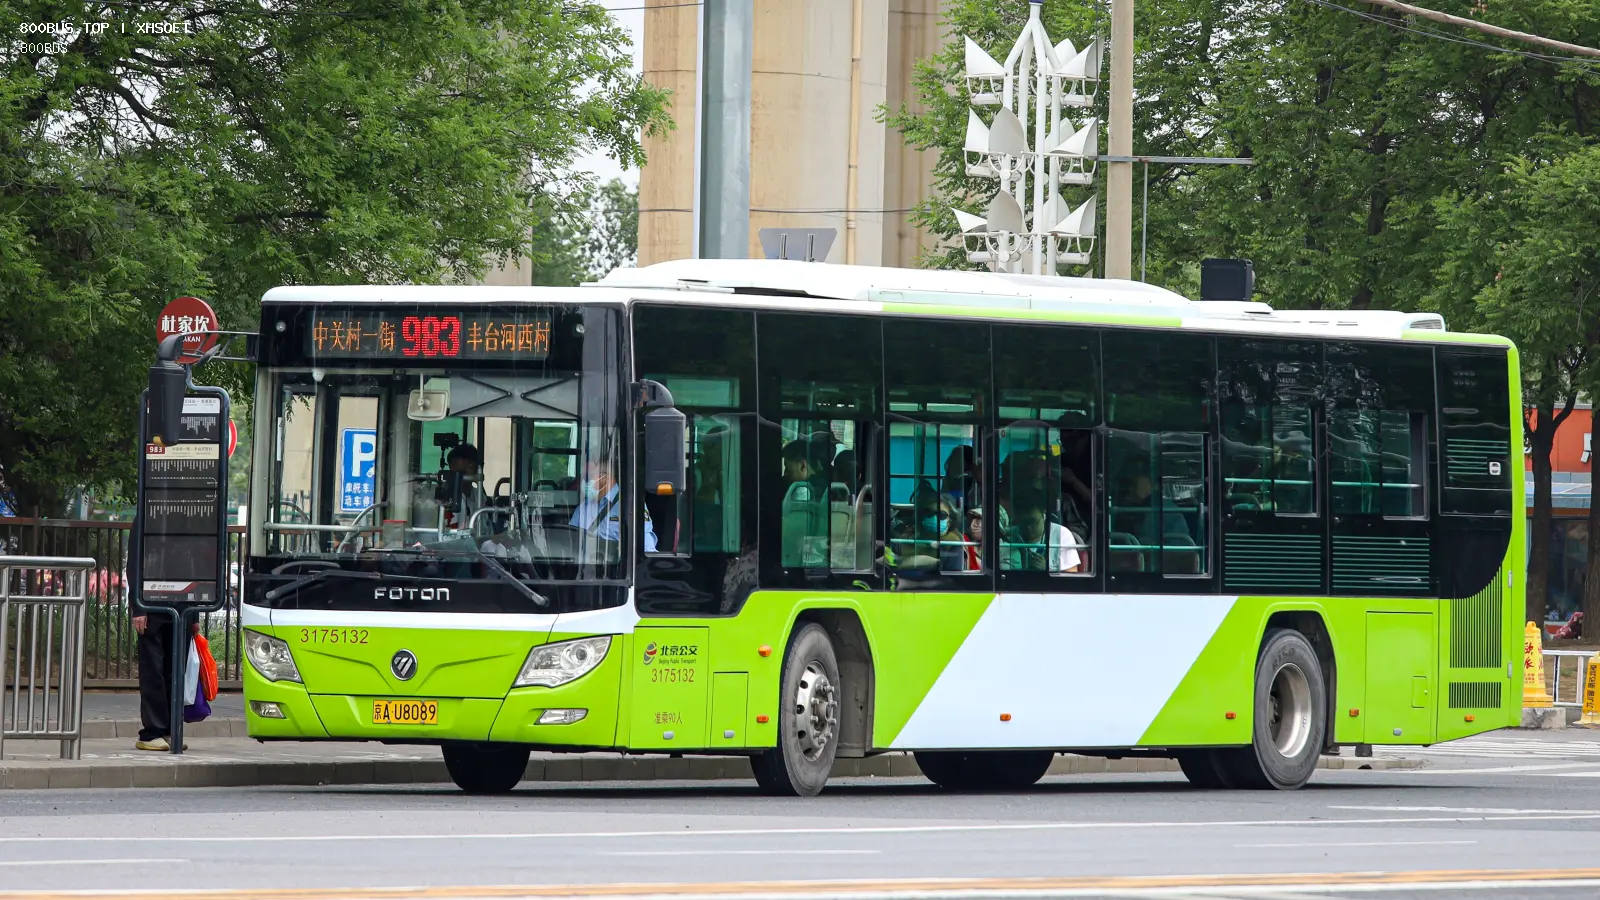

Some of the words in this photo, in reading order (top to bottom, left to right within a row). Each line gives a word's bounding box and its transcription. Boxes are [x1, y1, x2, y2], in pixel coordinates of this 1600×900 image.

[161, 314, 210, 333] 杜家坎
[313, 321, 396, 351] 中关村一街
[401, 316, 460, 356] 983
[467, 321, 550, 352] 丰台河西村
[351, 433, 377, 477] P
[374, 587, 450, 601] FOTON
[300, 628, 369, 644] 3175132
[659, 645, 698, 656] 北京公交
[651, 668, 695, 682] 3175132
